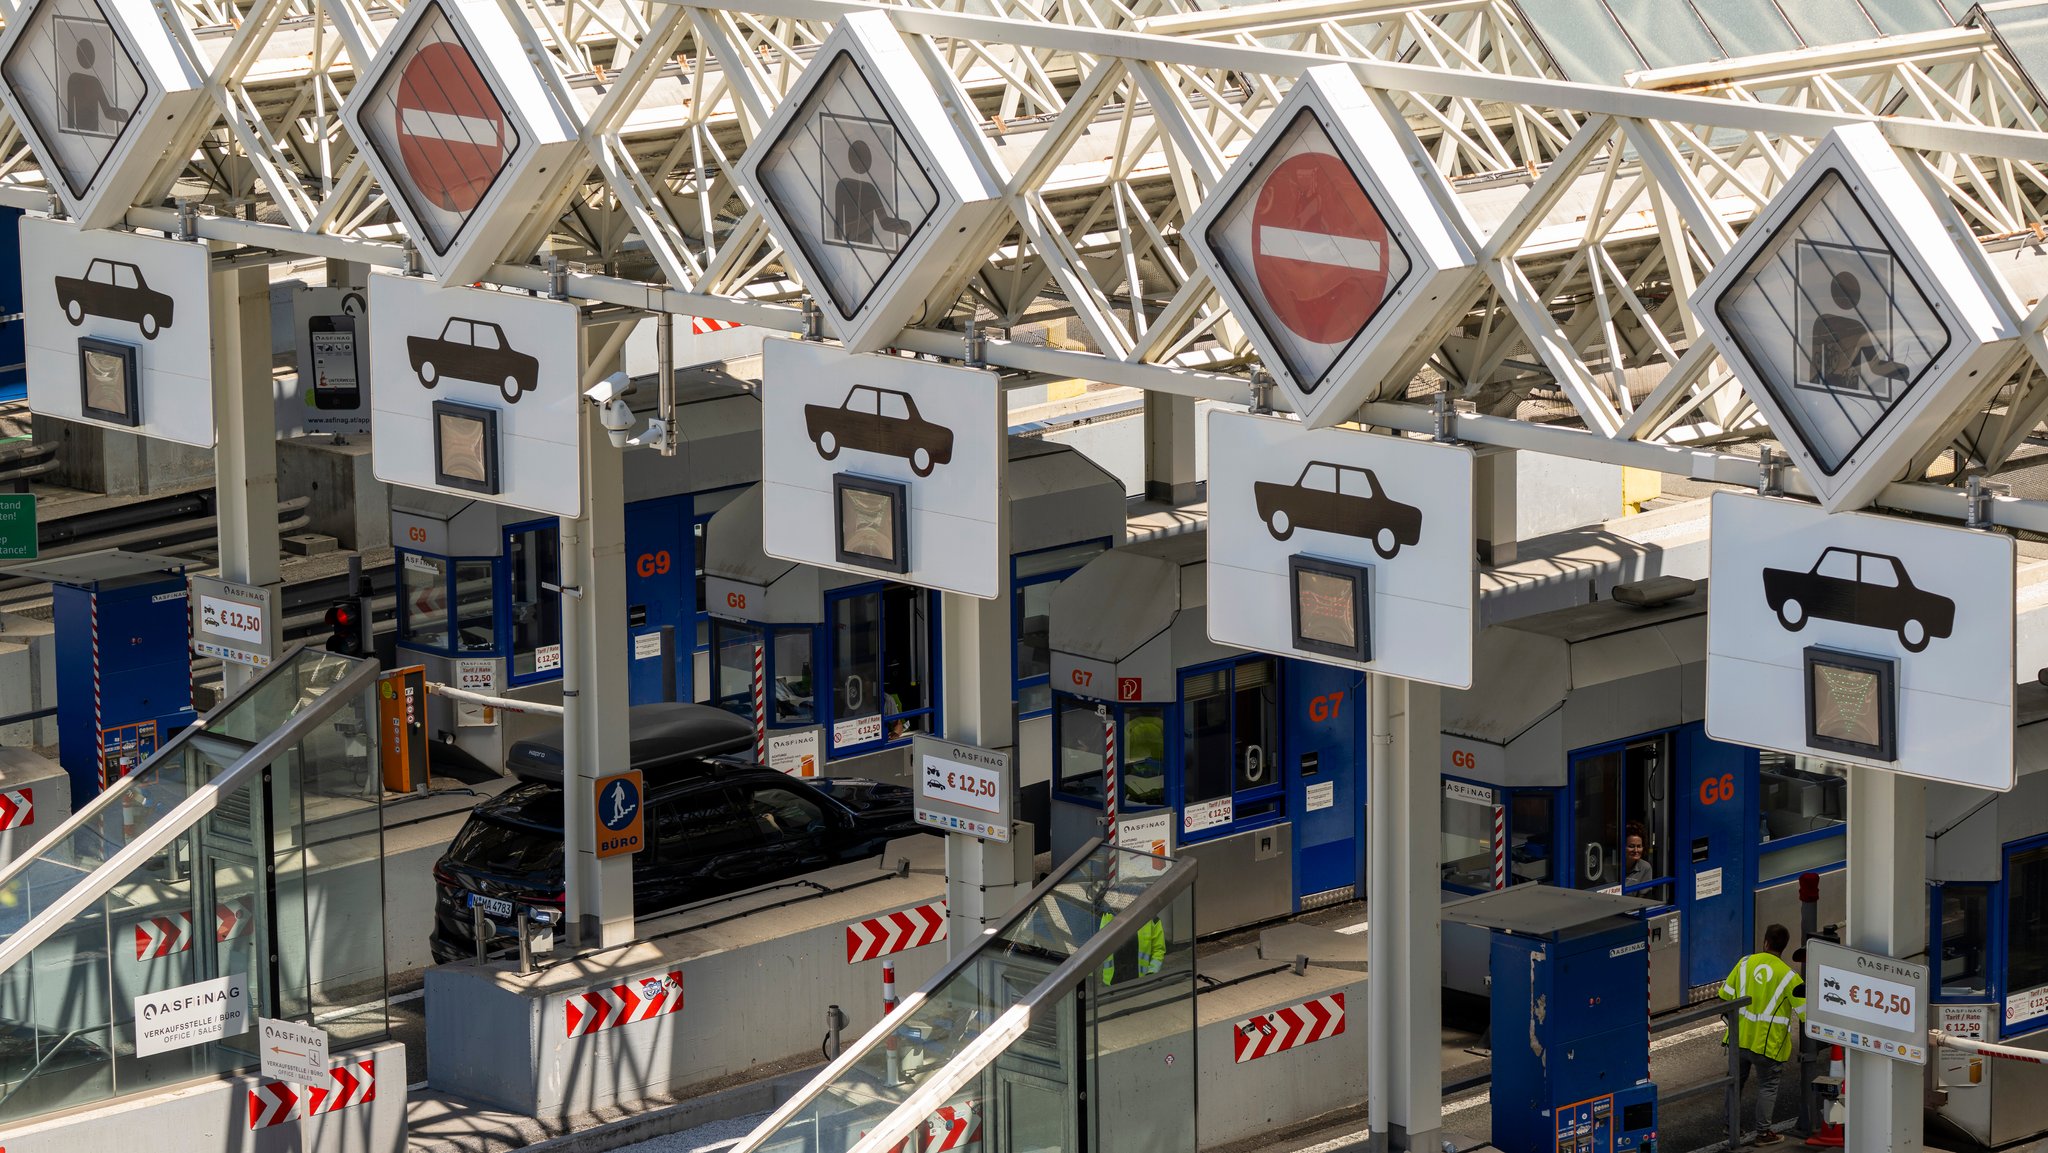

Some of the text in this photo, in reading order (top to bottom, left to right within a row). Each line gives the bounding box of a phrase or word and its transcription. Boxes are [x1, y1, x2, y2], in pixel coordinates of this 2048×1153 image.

[0, 501, 20, 509] tand
[409, 526, 426, 542] G9
[636, 550, 671, 578] G9
[231, 589, 264, 601] ASFiNAG
[727, 592, 746, 609] G8
[220, 610, 260, 631] € 12,50
[543, 653, 559, 662] 12,50
[1072, 669, 1093, 687] G7
[1309, 691, 1344, 722] G7
[863, 724, 880, 734] 12,50
[961, 752, 1003, 766] ASFiNAG
[1452, 750, 1475, 769] G6
[947, 772, 995, 797] € 12,50
[1447, 784, 1491, 798] ASFiNAG
[1700, 773, 1734, 805] G6
[1214, 807, 1230, 817] 12,50
[602, 835, 638, 851] BÜRO
[493, 901, 510, 914] 4783
[1868, 961, 1920, 979] ASFiNAG
[160, 986, 240, 1015] ASFiNAG
[1849, 985, 1910, 1015] € 12,50
[2036, 996, 2048, 1007] 12,5
[144, 1017, 213, 1038] VERKAUFSSTELLE
[220, 1010, 240, 1021] BÜRO
[1954, 1023, 1980, 1032] 12,50
[164, 1032, 191, 1044] OFFICE
[198, 1024, 222, 1036] SALES
[275, 1031, 322, 1047] ASFiNAG
[267, 1060, 307, 1073] VERKAUFSSTELLE
[311, 1068, 323, 1077] BÜRO
[298, 1073, 312, 1082] SALES
